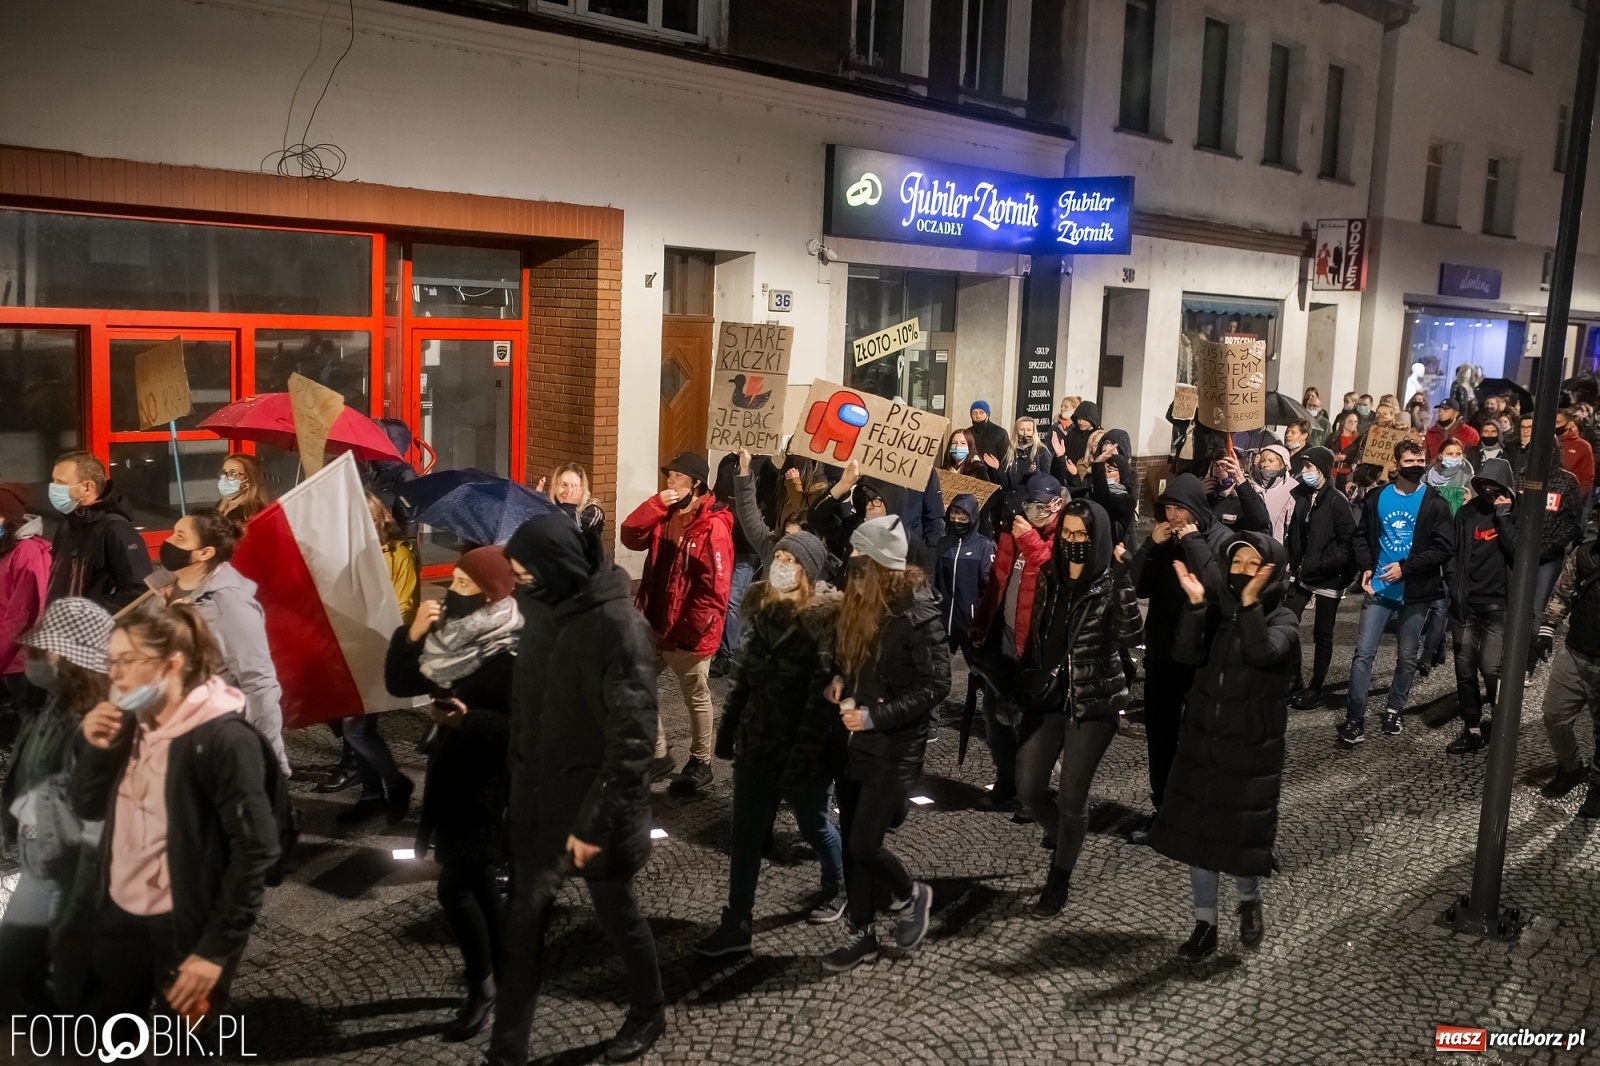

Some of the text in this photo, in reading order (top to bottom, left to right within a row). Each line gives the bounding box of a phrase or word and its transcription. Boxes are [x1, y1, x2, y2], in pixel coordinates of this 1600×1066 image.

[900, 171, 1039, 230] Jubiler Złotnik
[1058, 190, 1115, 219] Jubiler
[916, 218, 964, 236] OCZADŁY
[1056, 222, 1114, 246] Złotnik
[1122, 268, 1135, 283] 38
[775, 293, 791, 307] 36
[724, 324, 787, 351] STARE
[855, 322, 919, 362] ZŁOTO -10%
[720, 349, 782, 372] KACZKI
[715, 404, 775, 429] JEBAĆ
[886, 403, 923, 431] PIS
[867, 422, 939, 457] FEJKUJE
[861, 443, 918, 478] TASKI
[1391, 520, 1407, 529] 4F
